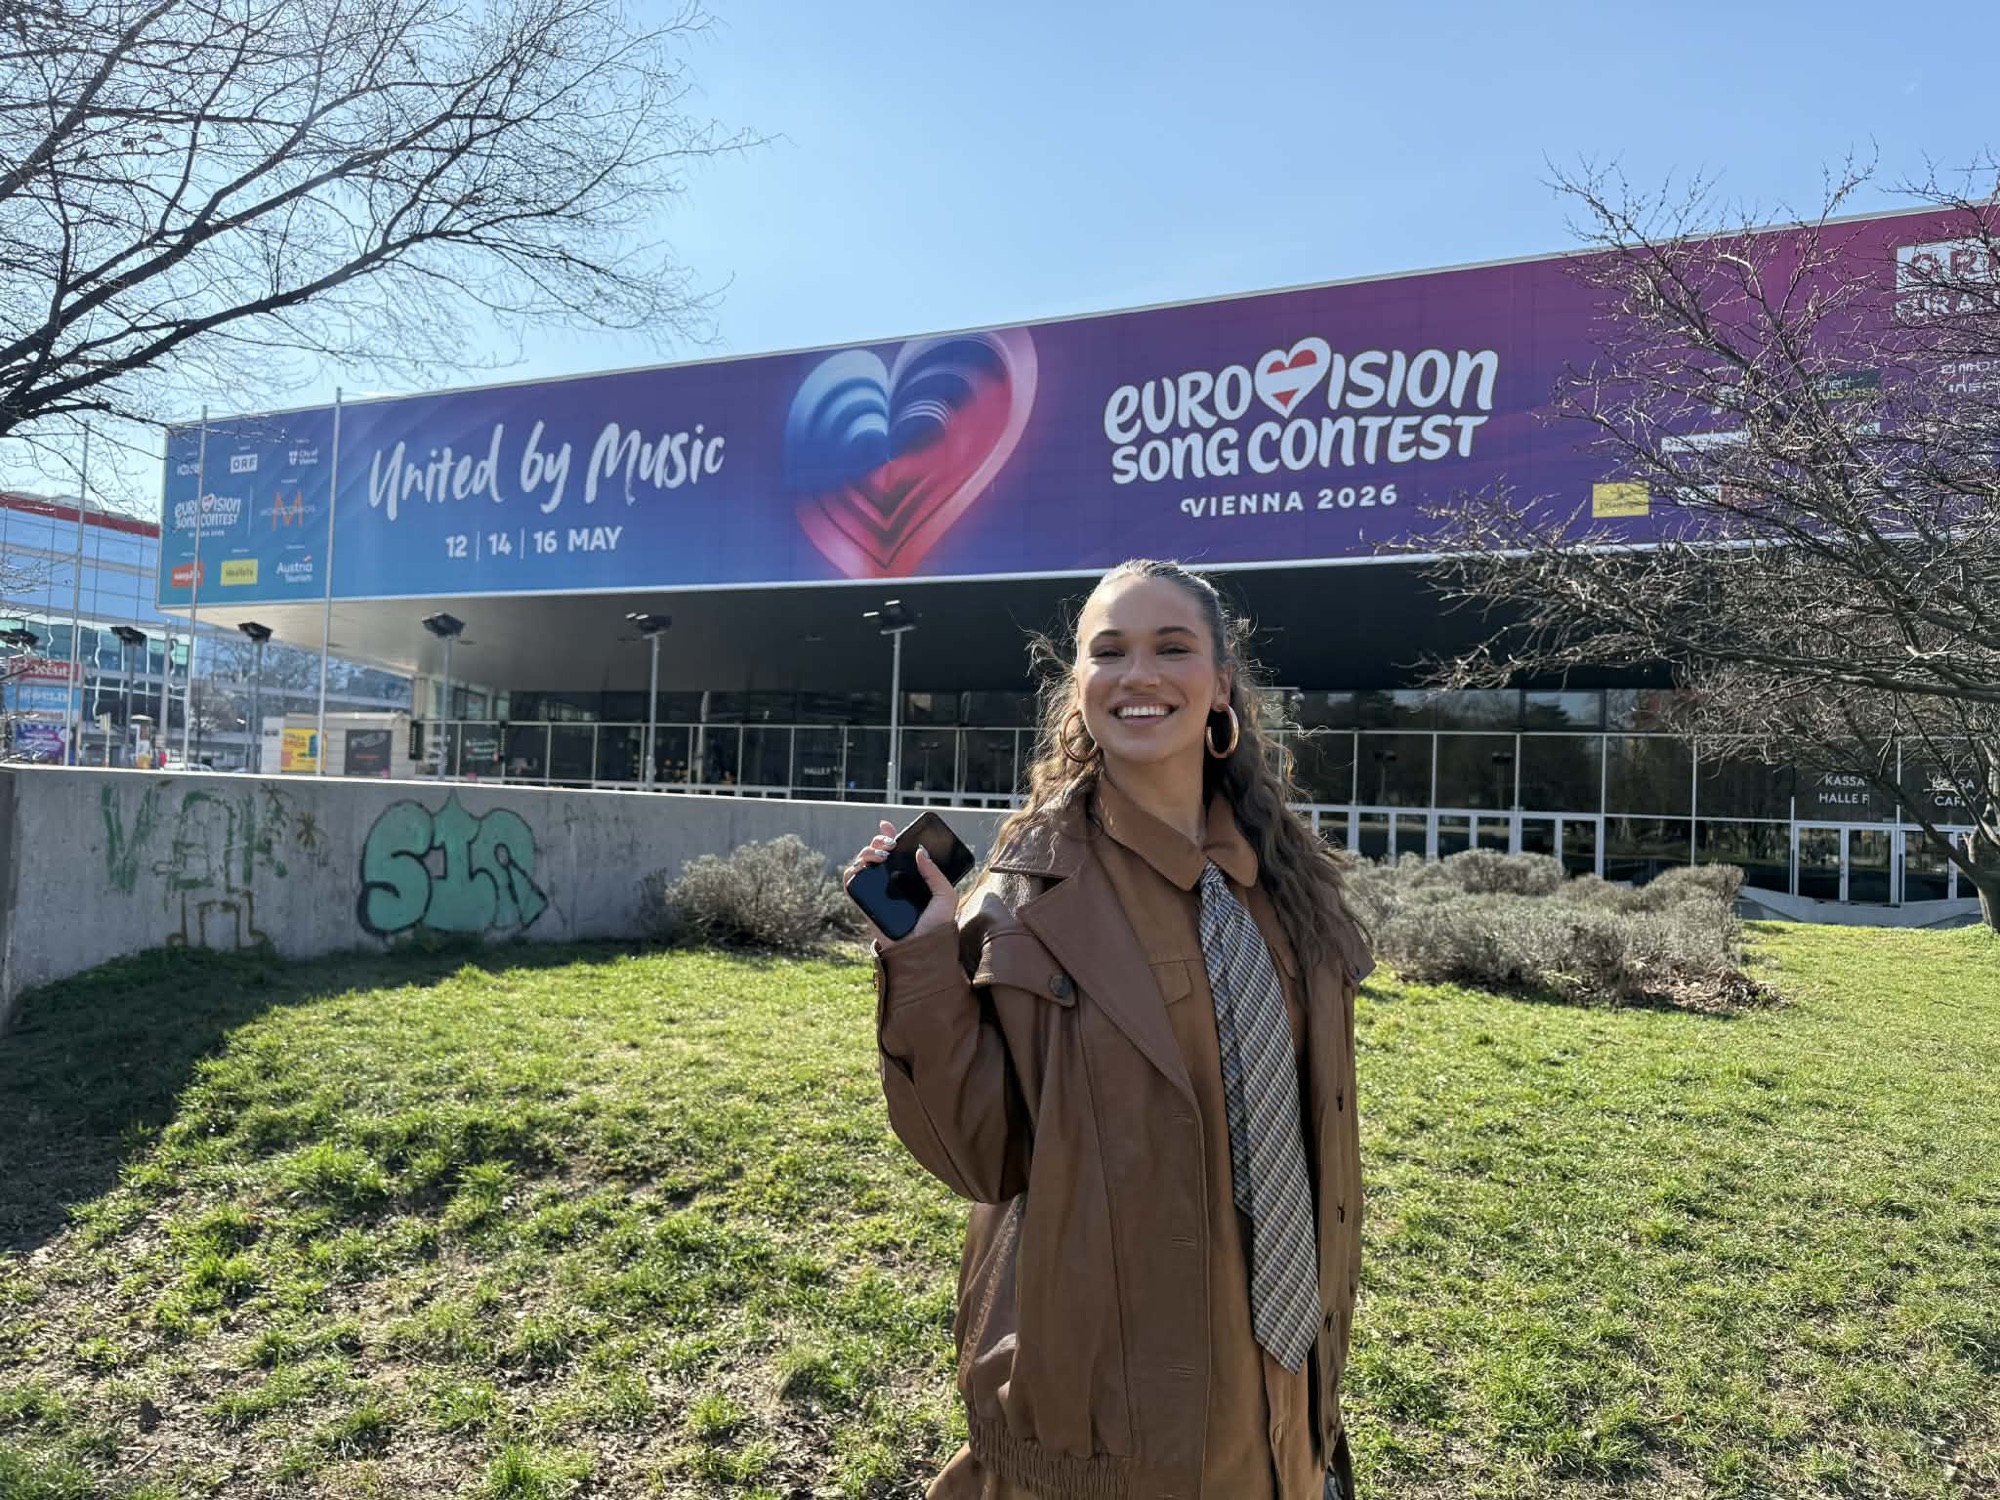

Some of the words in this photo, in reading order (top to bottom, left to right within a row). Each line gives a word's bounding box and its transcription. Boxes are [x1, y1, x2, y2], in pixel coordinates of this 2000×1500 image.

[232, 457, 257, 470] ORF
[1112, 427, 1239, 485] SONG
[1247, 415, 1489, 475] CONTEST
[369, 423, 504, 521] United
[520, 420, 572, 514] by
[585, 422, 725, 506] Music
[1181, 491, 1304, 518] VIENNA
[1317, 484, 1398, 509] 2026
[446, 533, 468, 559] 12
[488, 532, 512, 556] 14
[533, 529, 558, 554] 16
[568, 526, 623, 552] MAY
[1825, 774, 1866, 787] KASSA
[1819, 792, 1859, 805] HALLE
